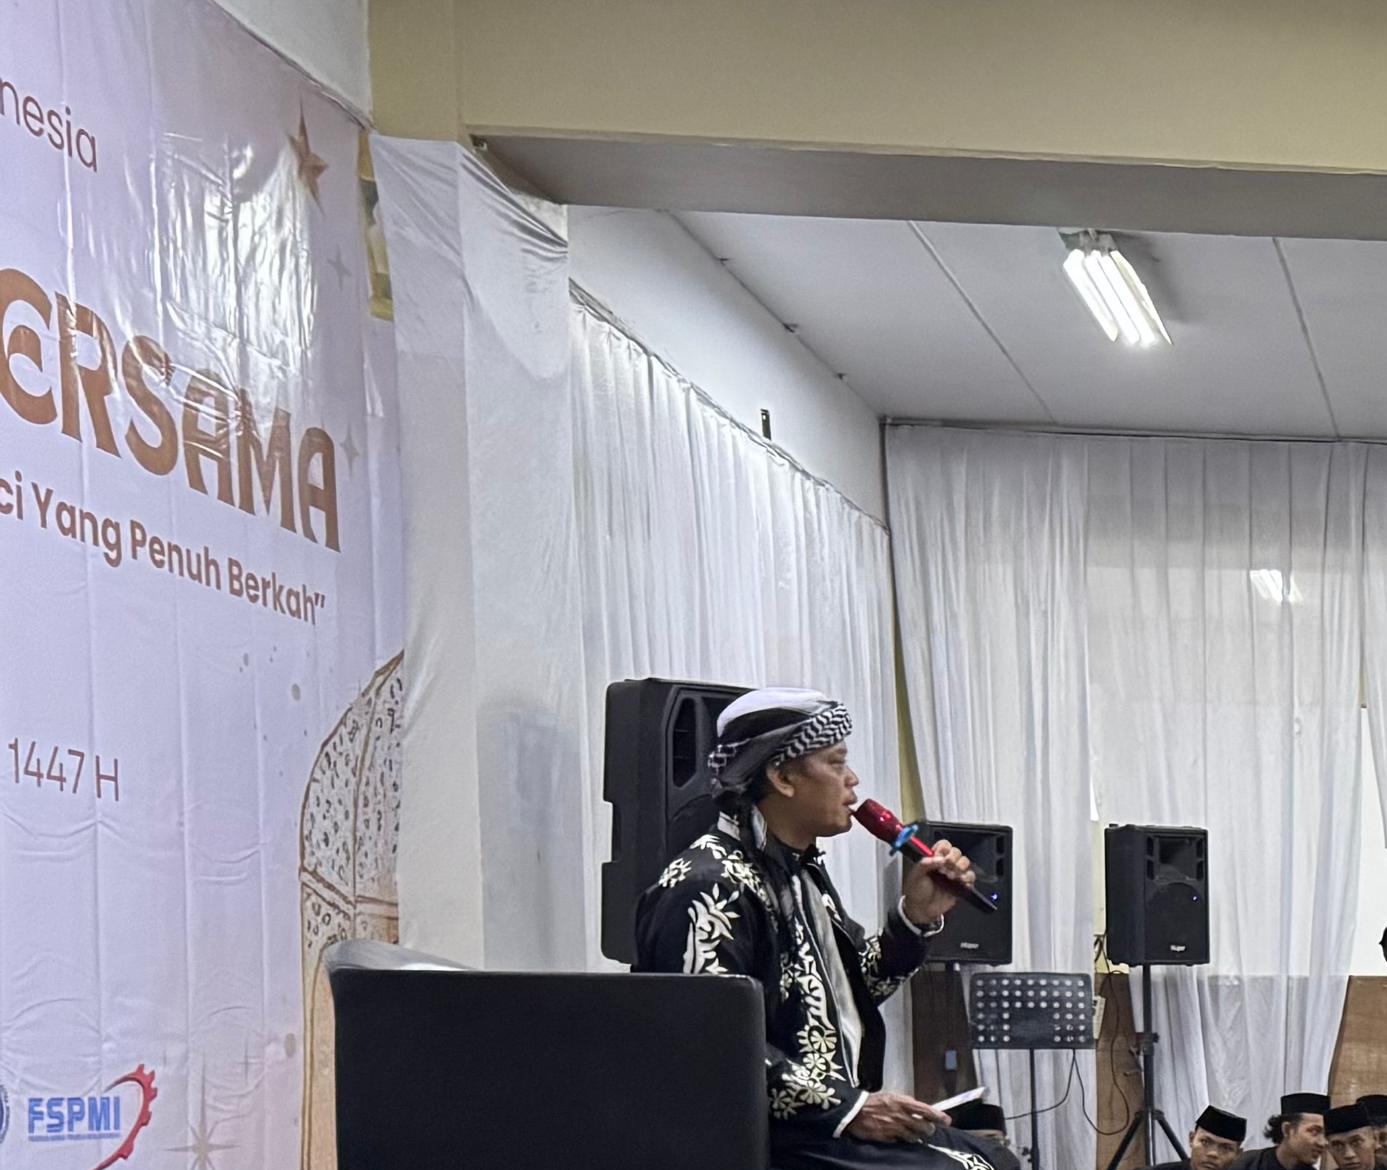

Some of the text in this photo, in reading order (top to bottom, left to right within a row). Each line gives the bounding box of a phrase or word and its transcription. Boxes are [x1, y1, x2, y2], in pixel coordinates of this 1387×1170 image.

[31, 481, 122, 568] Yang
[130, 519, 221, 591] Penuh
[8, 737, 119, 802] 1447 H
[28, 1096, 120, 1134] FSPMI
